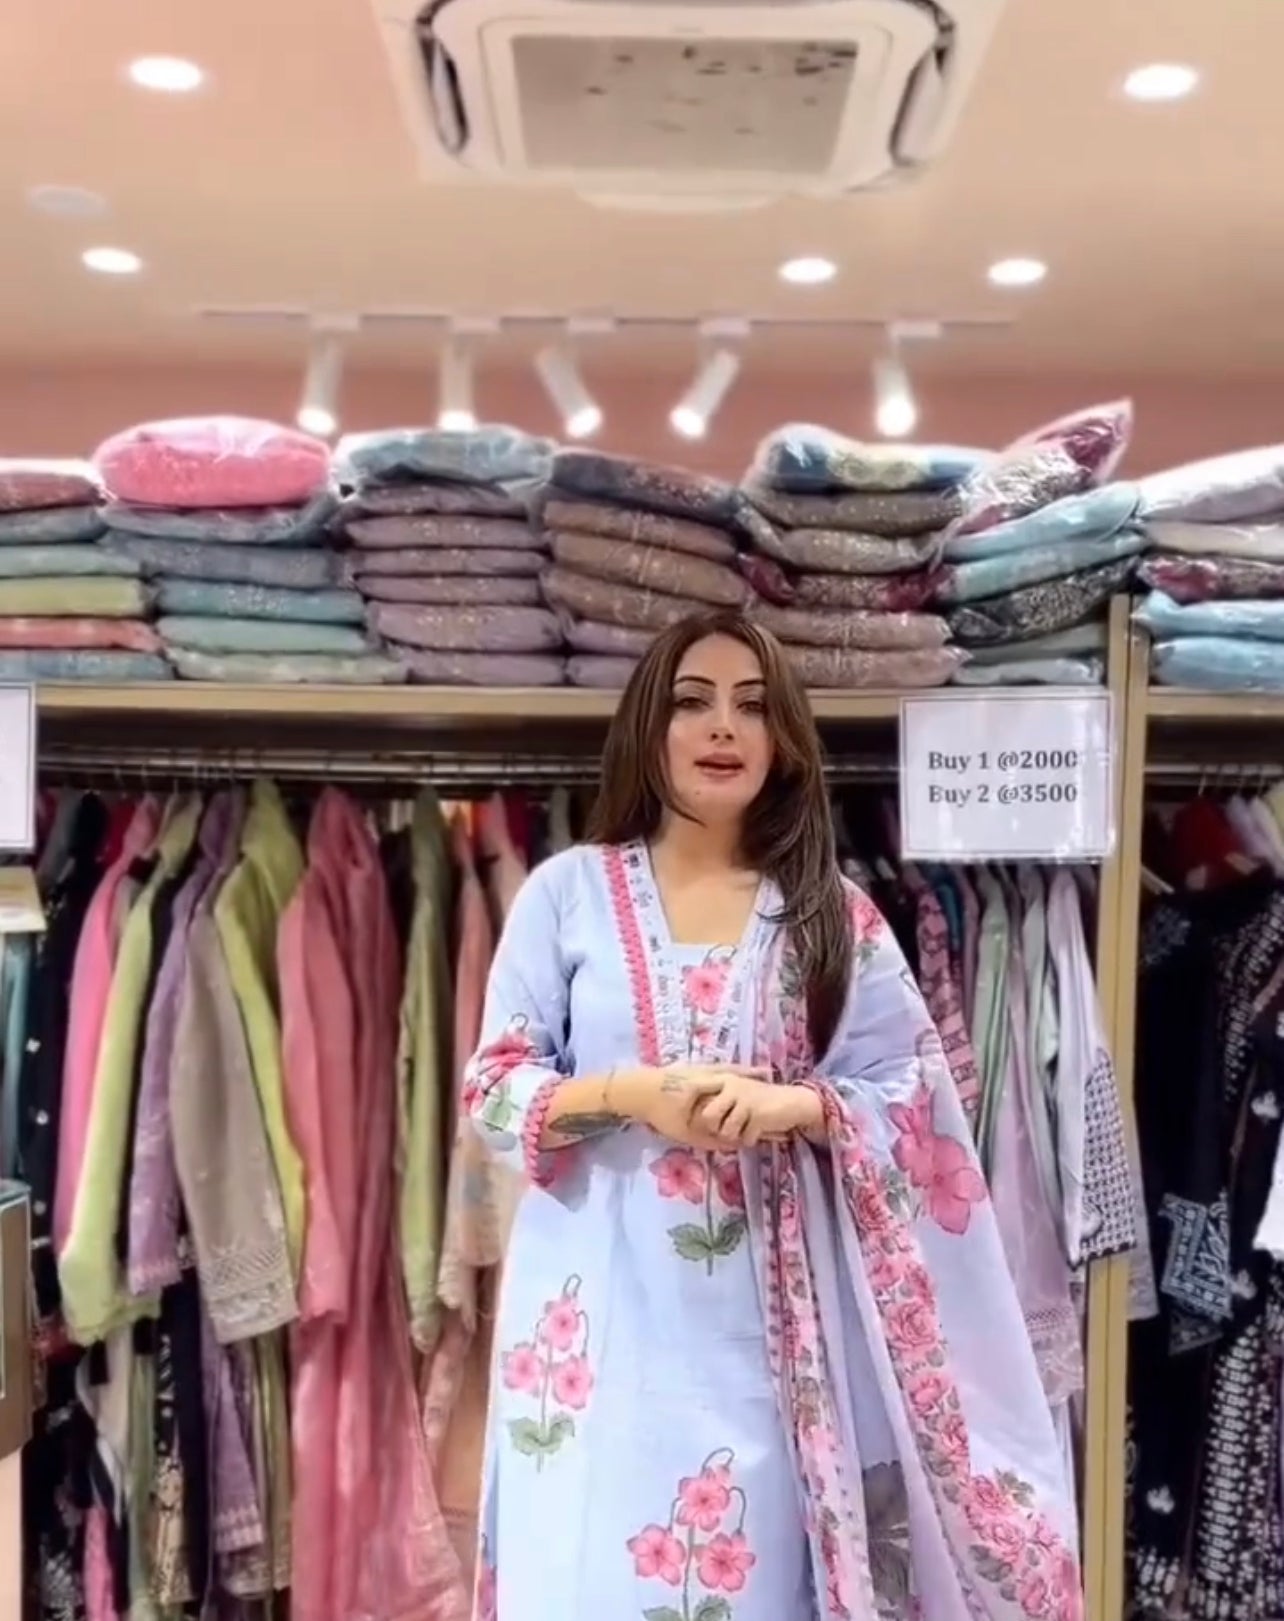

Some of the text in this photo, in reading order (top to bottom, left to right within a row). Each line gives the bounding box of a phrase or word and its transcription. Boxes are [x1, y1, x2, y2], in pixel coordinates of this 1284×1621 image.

[928, 750, 1078, 774] Buy 1 @2000
[928, 783, 1078, 807] Buy 2 @3500
